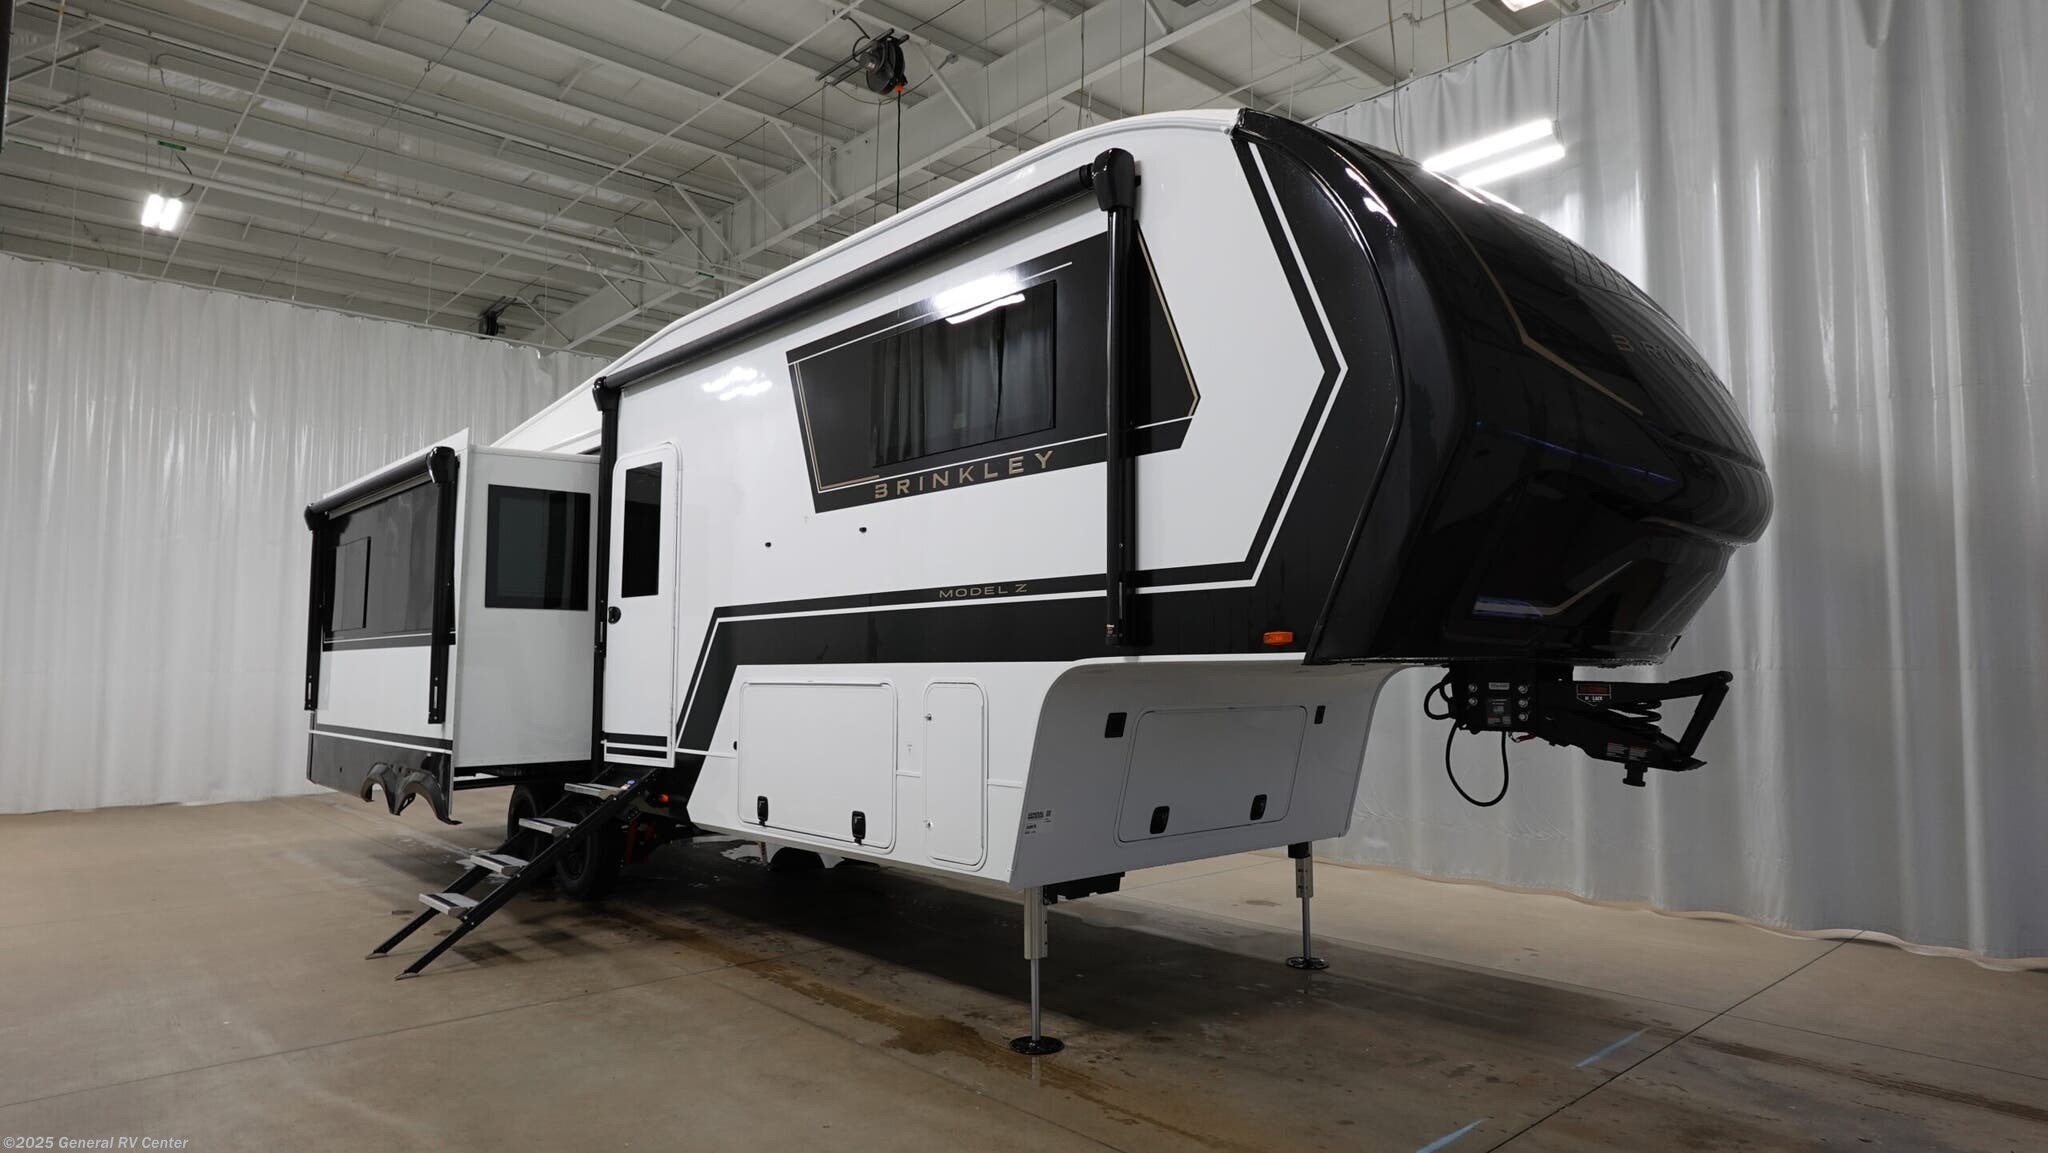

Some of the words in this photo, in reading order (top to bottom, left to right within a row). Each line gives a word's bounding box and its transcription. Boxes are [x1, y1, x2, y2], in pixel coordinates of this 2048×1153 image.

[874, 450, 1053, 499] BRINKLEY
[939, 585, 1008, 599] MODEL
[1015, 583, 1028, 593] Z
